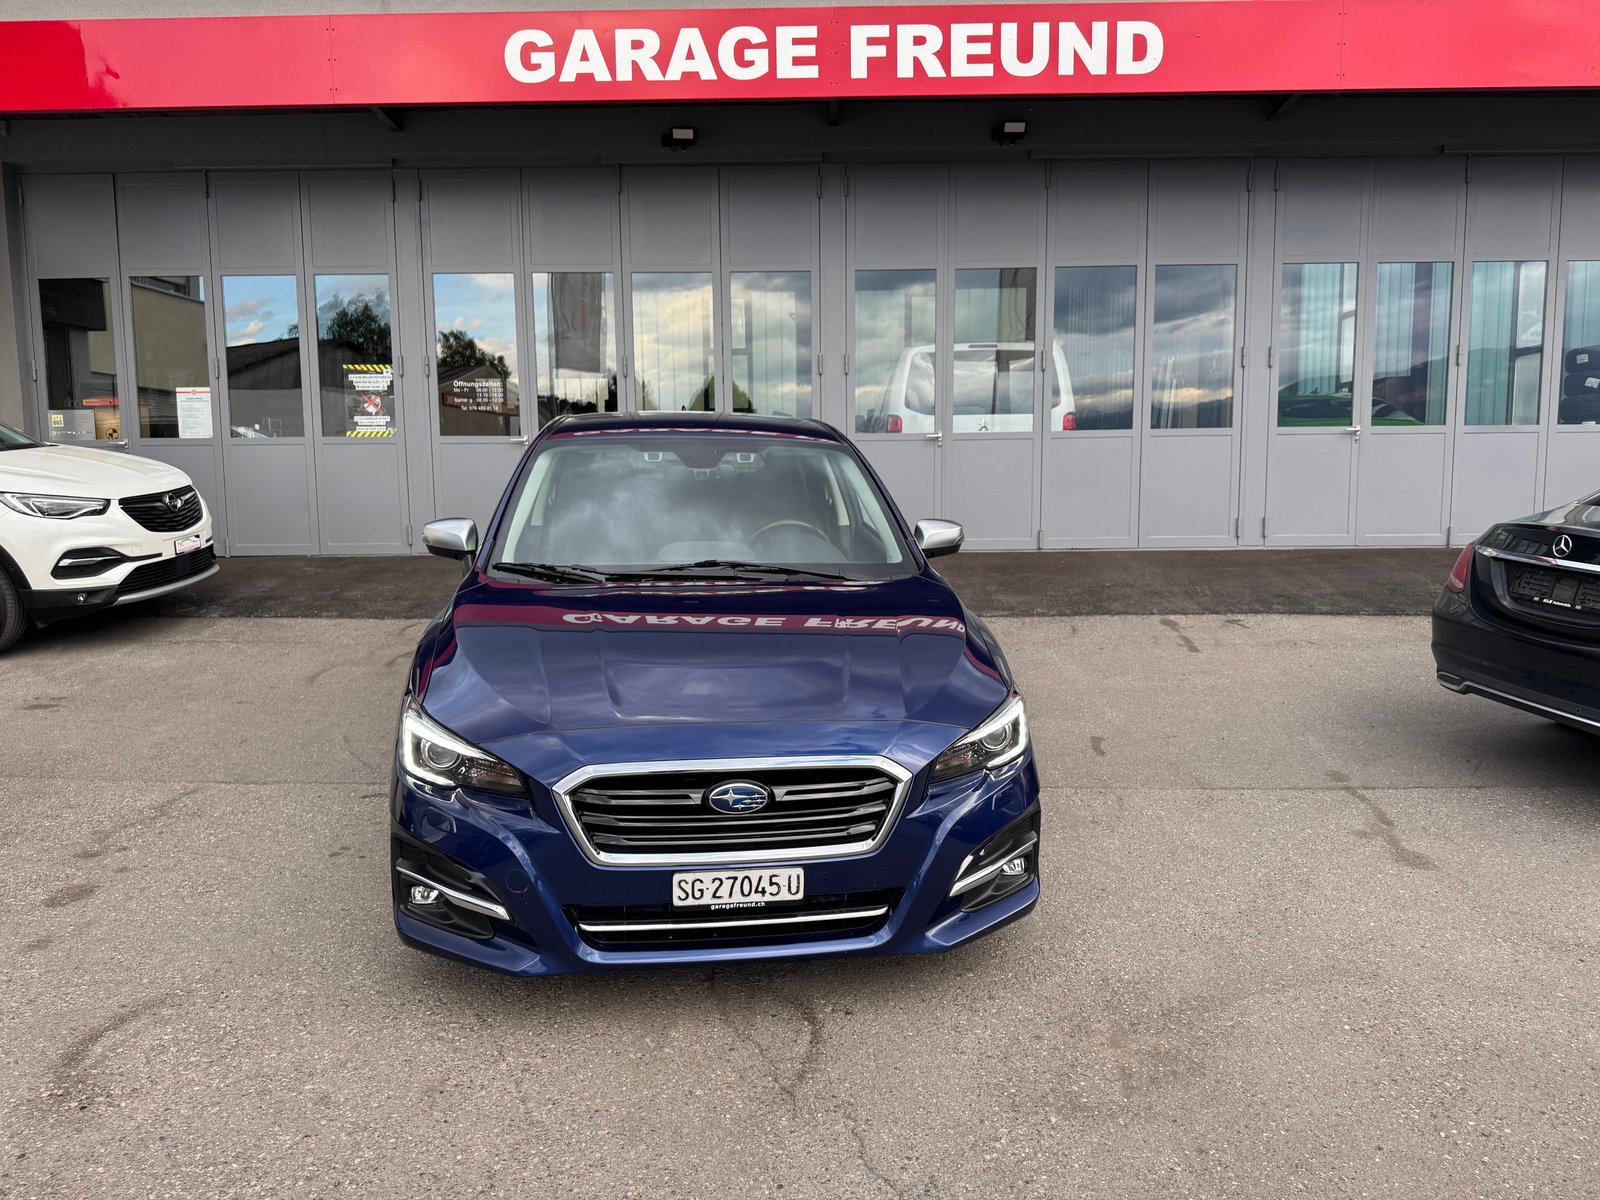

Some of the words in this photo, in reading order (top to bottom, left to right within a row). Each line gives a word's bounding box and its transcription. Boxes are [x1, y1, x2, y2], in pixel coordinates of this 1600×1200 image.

[504, 25, 819, 83] GARAGE
[850, 20, 1164, 79] FREUND
[453, 380, 503, 388] Öffnungszeiten:
[710, 901, 766, 910] garagefreund.ch
